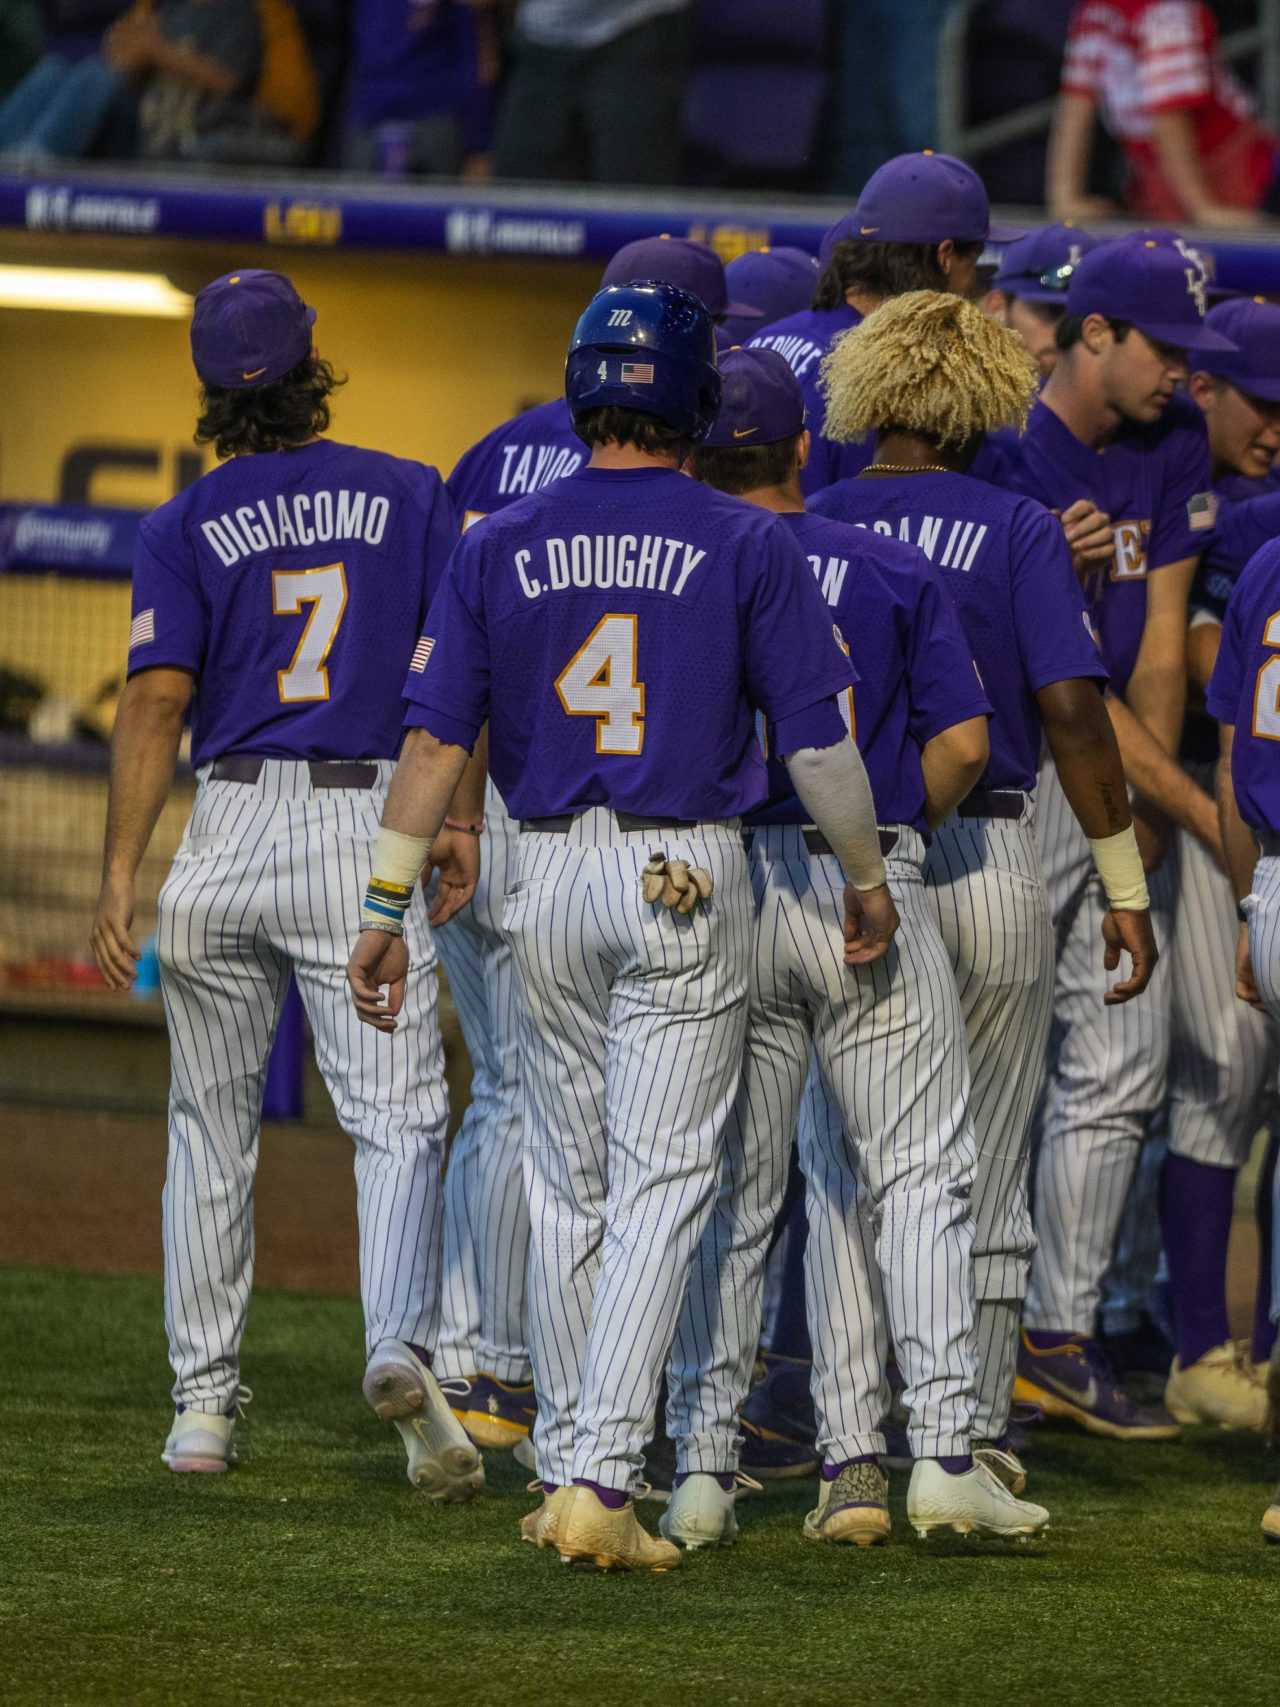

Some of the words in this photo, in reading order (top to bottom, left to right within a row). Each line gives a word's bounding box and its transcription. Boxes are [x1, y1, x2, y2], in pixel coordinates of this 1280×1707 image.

[200, 489, 391, 568] DIGIACOMO
[513, 534, 707, 599] C.DOUGHTY
[271, 561, 349, 704] 7
[553, 612, 646, 756] 4
